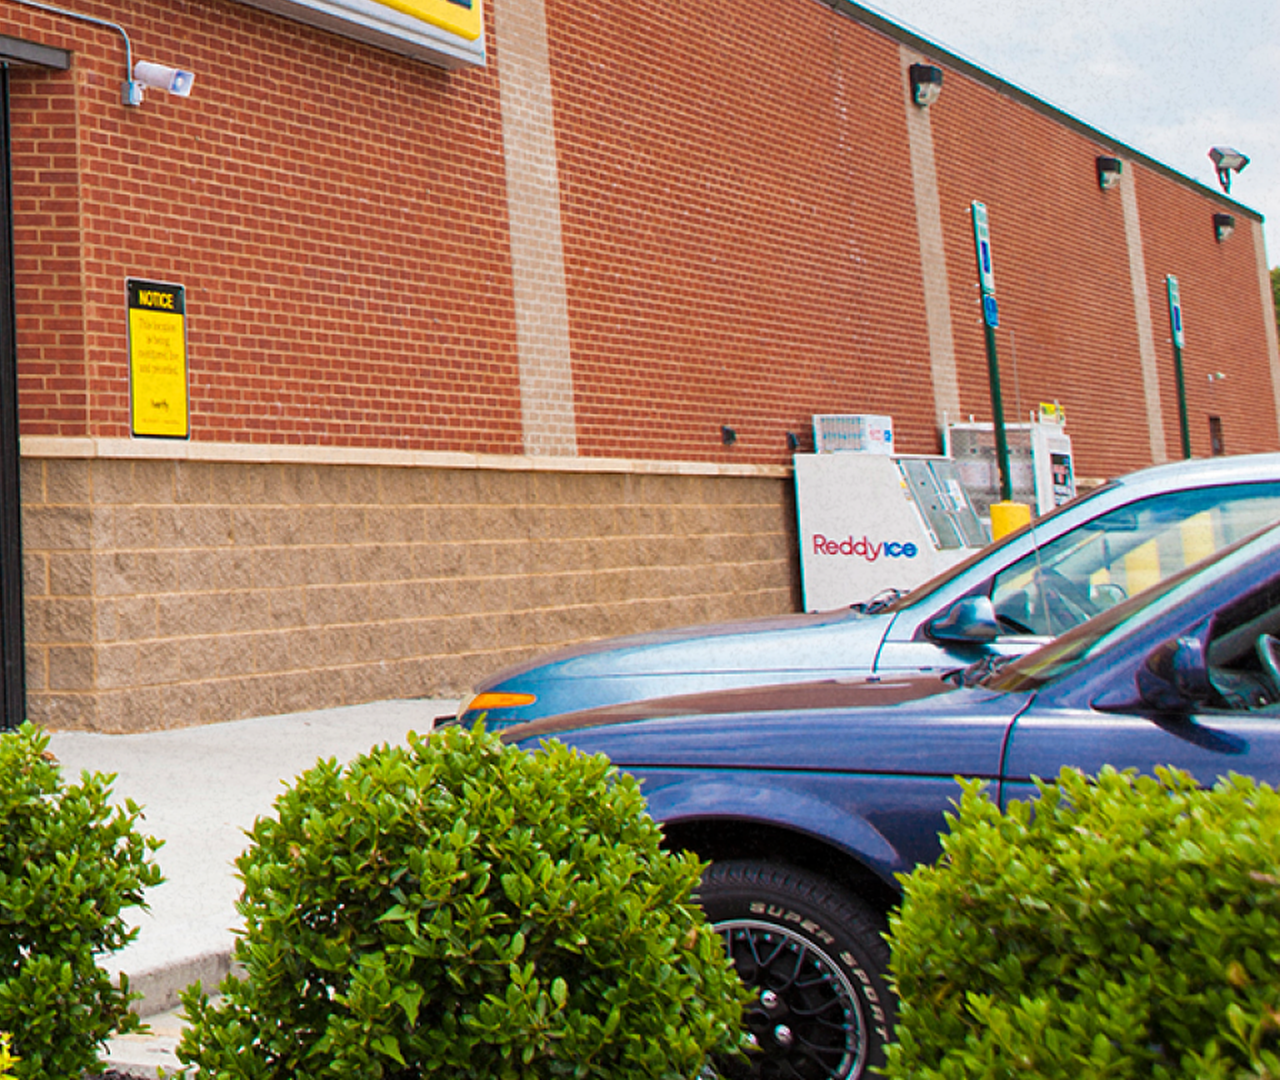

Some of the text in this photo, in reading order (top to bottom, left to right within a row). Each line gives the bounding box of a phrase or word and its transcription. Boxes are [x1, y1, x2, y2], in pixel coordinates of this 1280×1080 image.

[139, 289, 174, 309] NOTICE
[749, 901, 835, 945] SUPER
[839, 951, 890, 1041] SPORT
